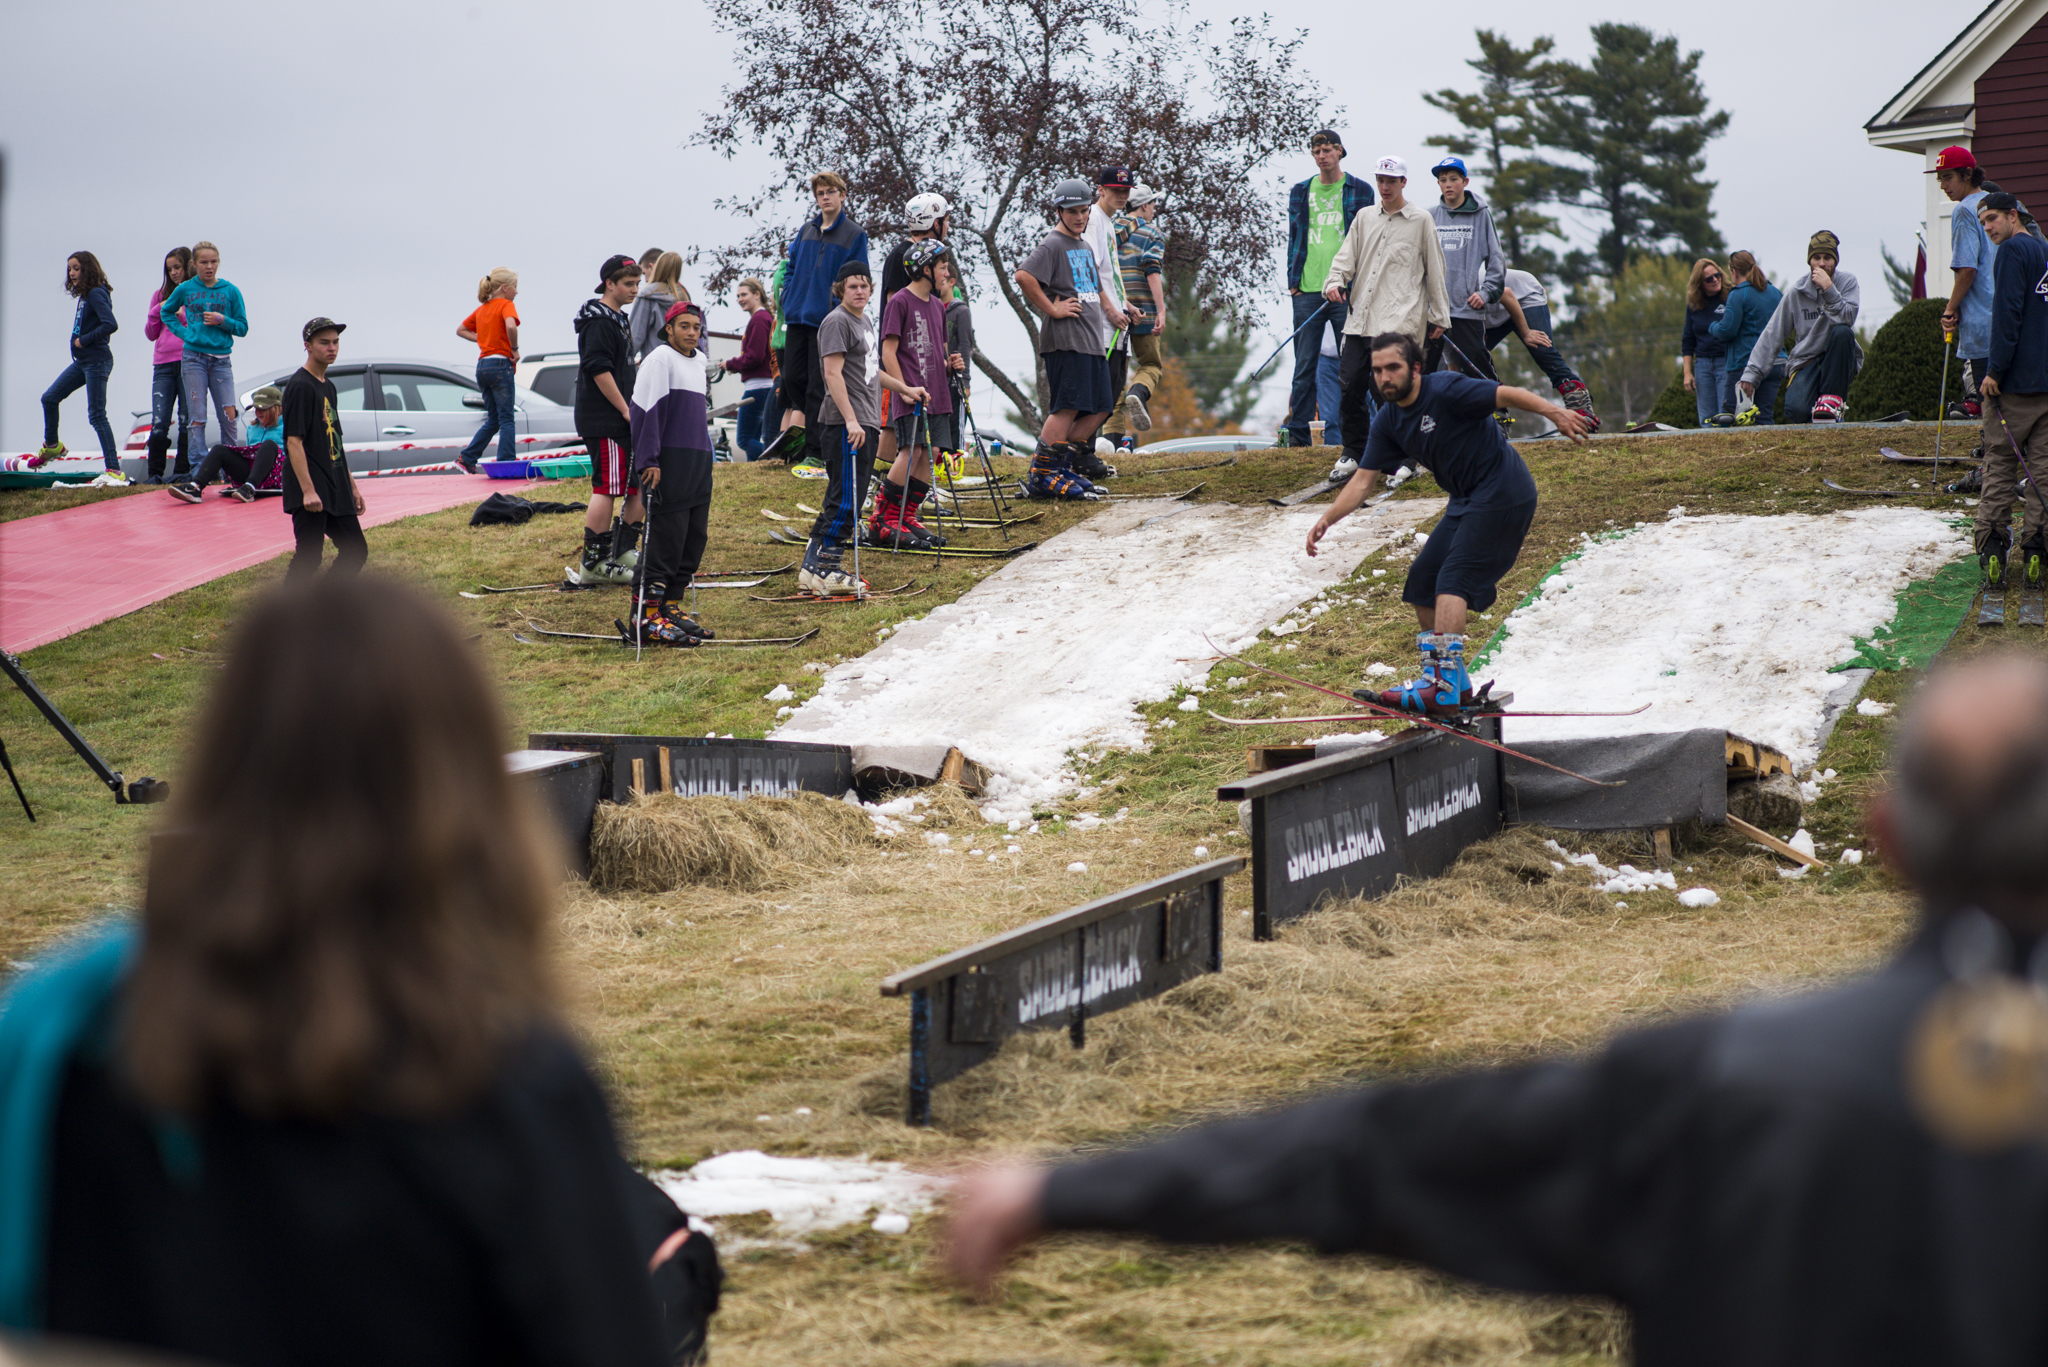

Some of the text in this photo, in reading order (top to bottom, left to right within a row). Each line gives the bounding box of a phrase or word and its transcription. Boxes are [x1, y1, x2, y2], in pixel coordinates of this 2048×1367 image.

[674, 757, 800, 800] SADDLEBACK
[1406, 757, 1481, 836] SADDLEBACK
[1285, 801, 1385, 883] SADDLEBACK
